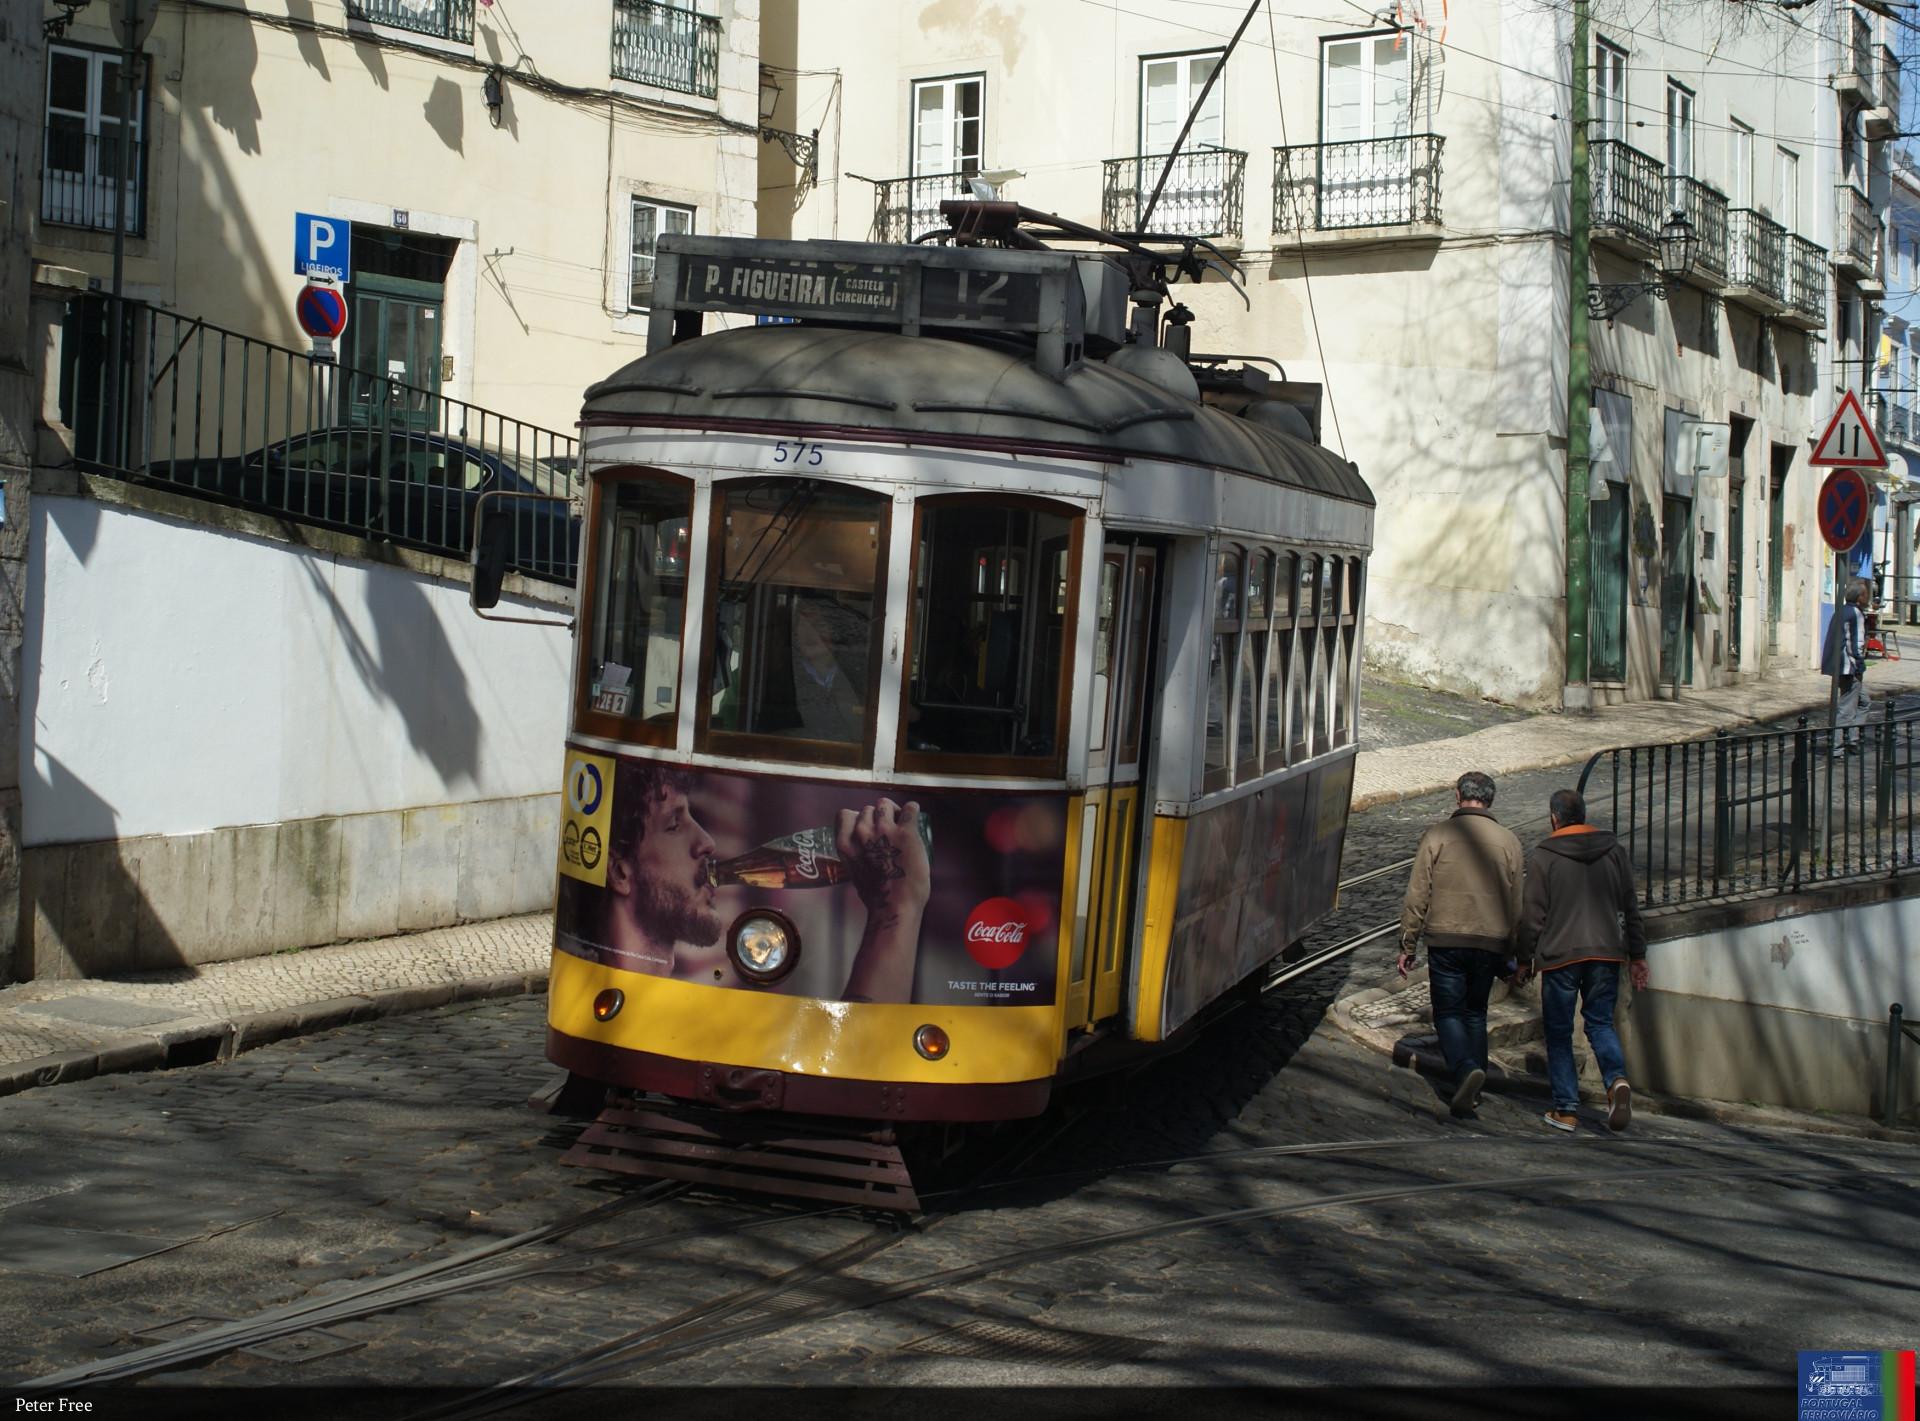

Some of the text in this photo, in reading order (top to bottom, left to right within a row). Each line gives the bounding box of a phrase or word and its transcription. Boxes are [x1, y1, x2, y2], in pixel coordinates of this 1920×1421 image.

[396, 212, 407, 225] 60
[309, 219, 336, 261] P
[301, 261, 343, 277] LIGEIROS
[704, 264, 725, 295] P.
[730, 266, 826, 305] FIGUEIRA
[846, 278, 884, 292] CASTELO
[957, 270, 1009, 305] 12
[773, 441, 823, 466] 575
[967, 920, 1026, 943] Coca-Cola
[947, 981, 1035, 991] TASTE THE FEELING
